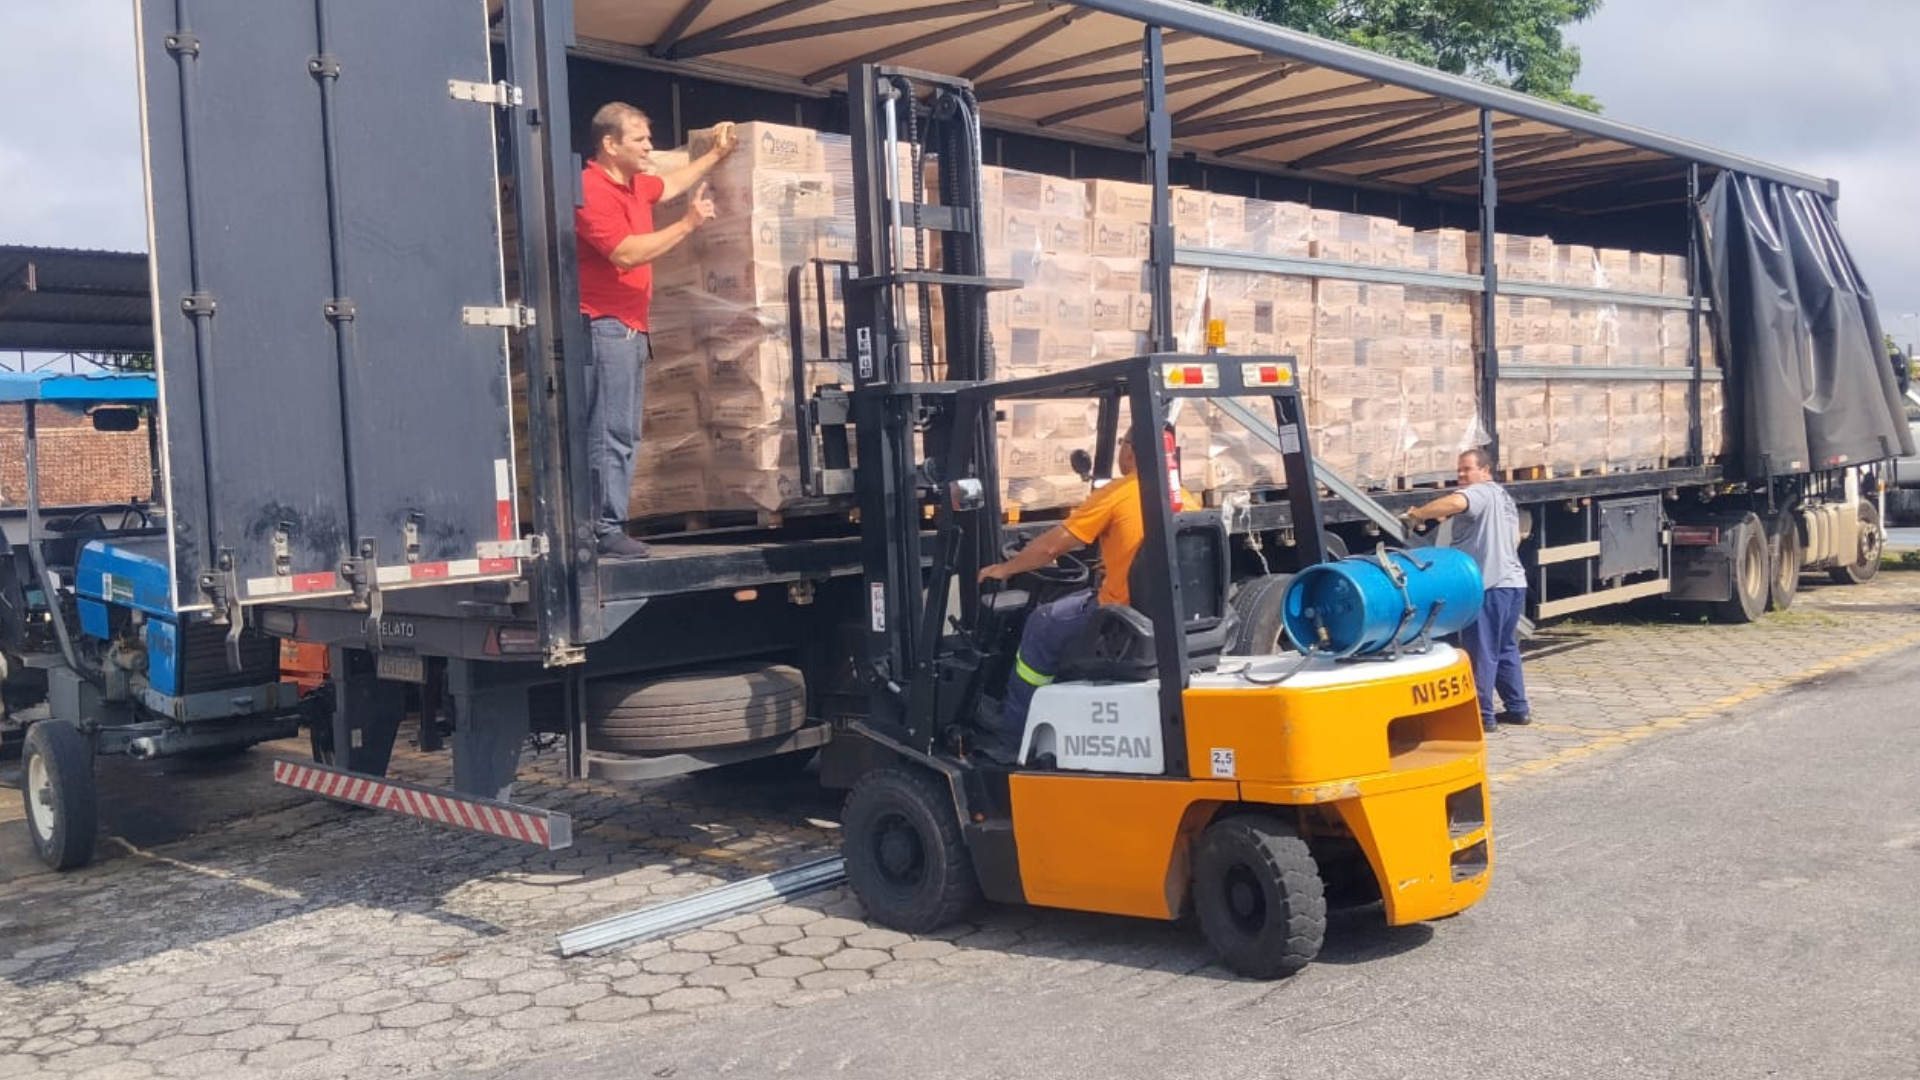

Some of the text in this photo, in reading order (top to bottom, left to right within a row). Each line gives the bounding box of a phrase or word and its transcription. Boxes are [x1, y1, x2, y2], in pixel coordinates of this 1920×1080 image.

[360, 619, 414, 637] LIELATO
[1091, 701, 1119, 724] 25
[1063, 735, 1152, 758] NISSAN
